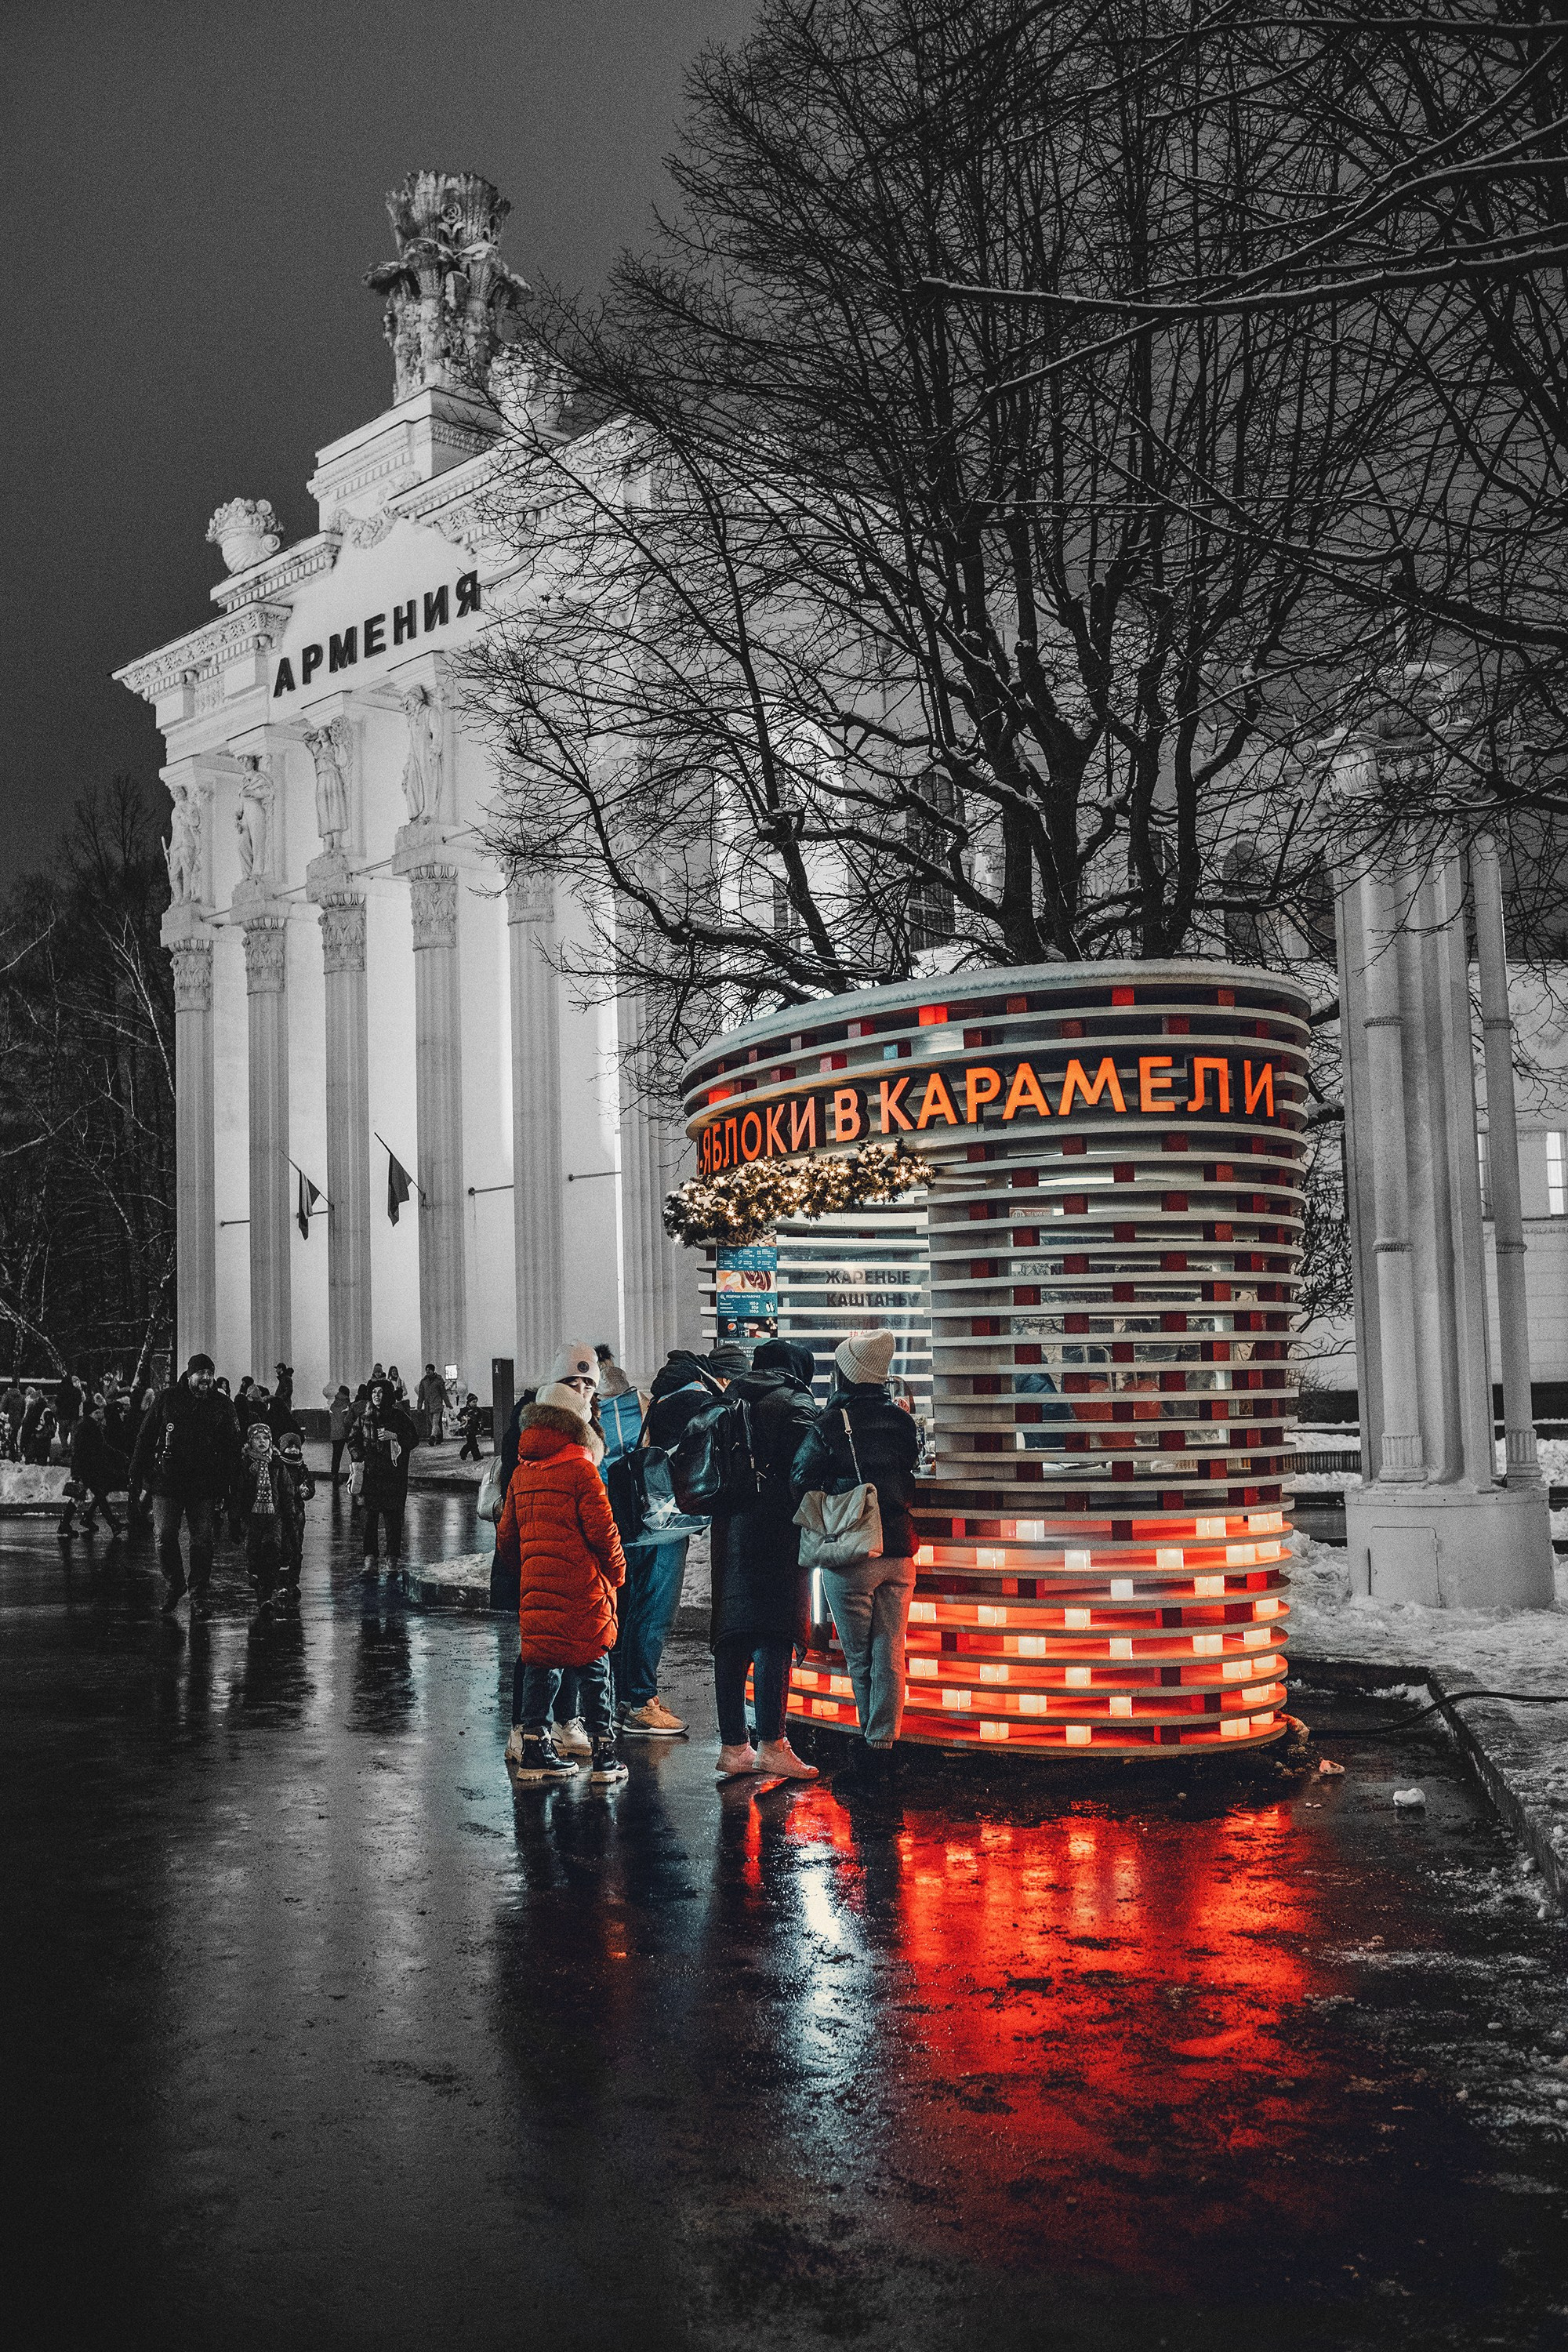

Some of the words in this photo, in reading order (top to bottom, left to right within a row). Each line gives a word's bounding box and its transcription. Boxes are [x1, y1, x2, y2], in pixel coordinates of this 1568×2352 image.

[274, 570, 481, 698] АРМЕНИЯ
[703, 1096, 817, 1175] ЯБЛОКИ
[834, 1088, 861, 1142] В
[881, 1056, 1275, 1134] КАРАМЕЛИ
[826, 1270, 910, 1284] ЖАРЕНЫЕ
[850, 1318, 915, 1327] CHNUTS
